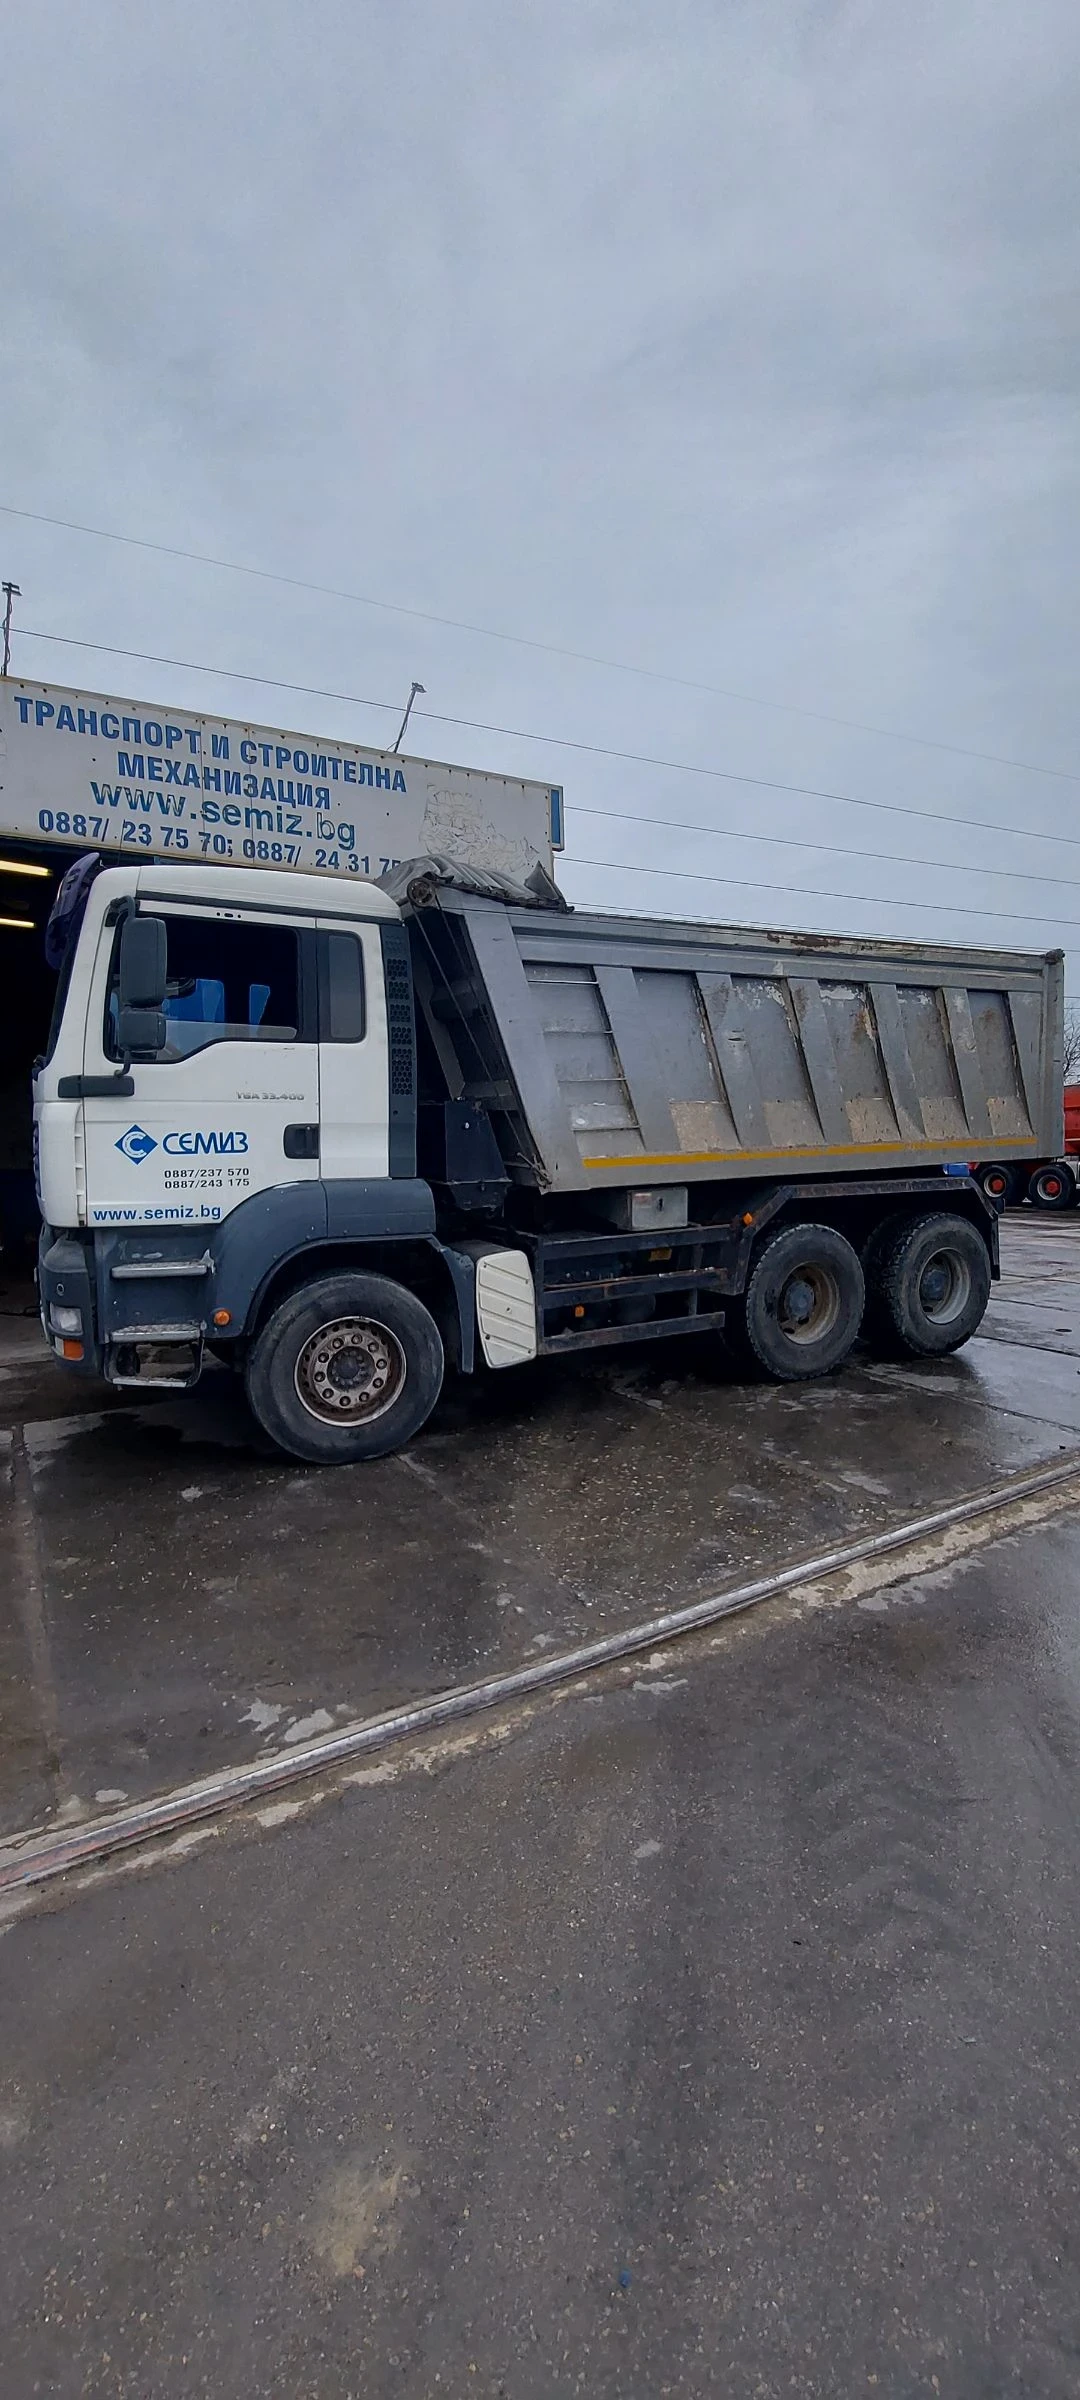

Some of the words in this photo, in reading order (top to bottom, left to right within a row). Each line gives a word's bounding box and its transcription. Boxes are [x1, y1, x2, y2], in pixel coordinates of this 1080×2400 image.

[14, 696, 201, 754] ТРАНСПОРТ
[211, 734, 230, 760] И
[240, 740, 407, 793] СТРОИТЕЛНА
[117, 751, 331, 810] МЕХАНИЗАЦИЯ
[90, 781, 355, 851] www.semiz.bg
[38, 809, 109, 842] 0887/
[123, 821, 152, 846] 23
[160, 826, 189, 849] 75
[199, 831, 233, 857] 70;
[242, 838, 302, 867] 0887/
[315, 848, 340, 870] 24
[348, 853, 370, 875] 31
[162, 1131, 249, 1155] СЕМИЗ
[164, 1168, 223, 1179] 0887/237
[227, 1167, 250, 1177] 570
[164, 1179, 223, 1189] 0887/243
[229, 1178, 250, 1188] 175
[93, 1205, 222, 1221] www.semiz.bg
